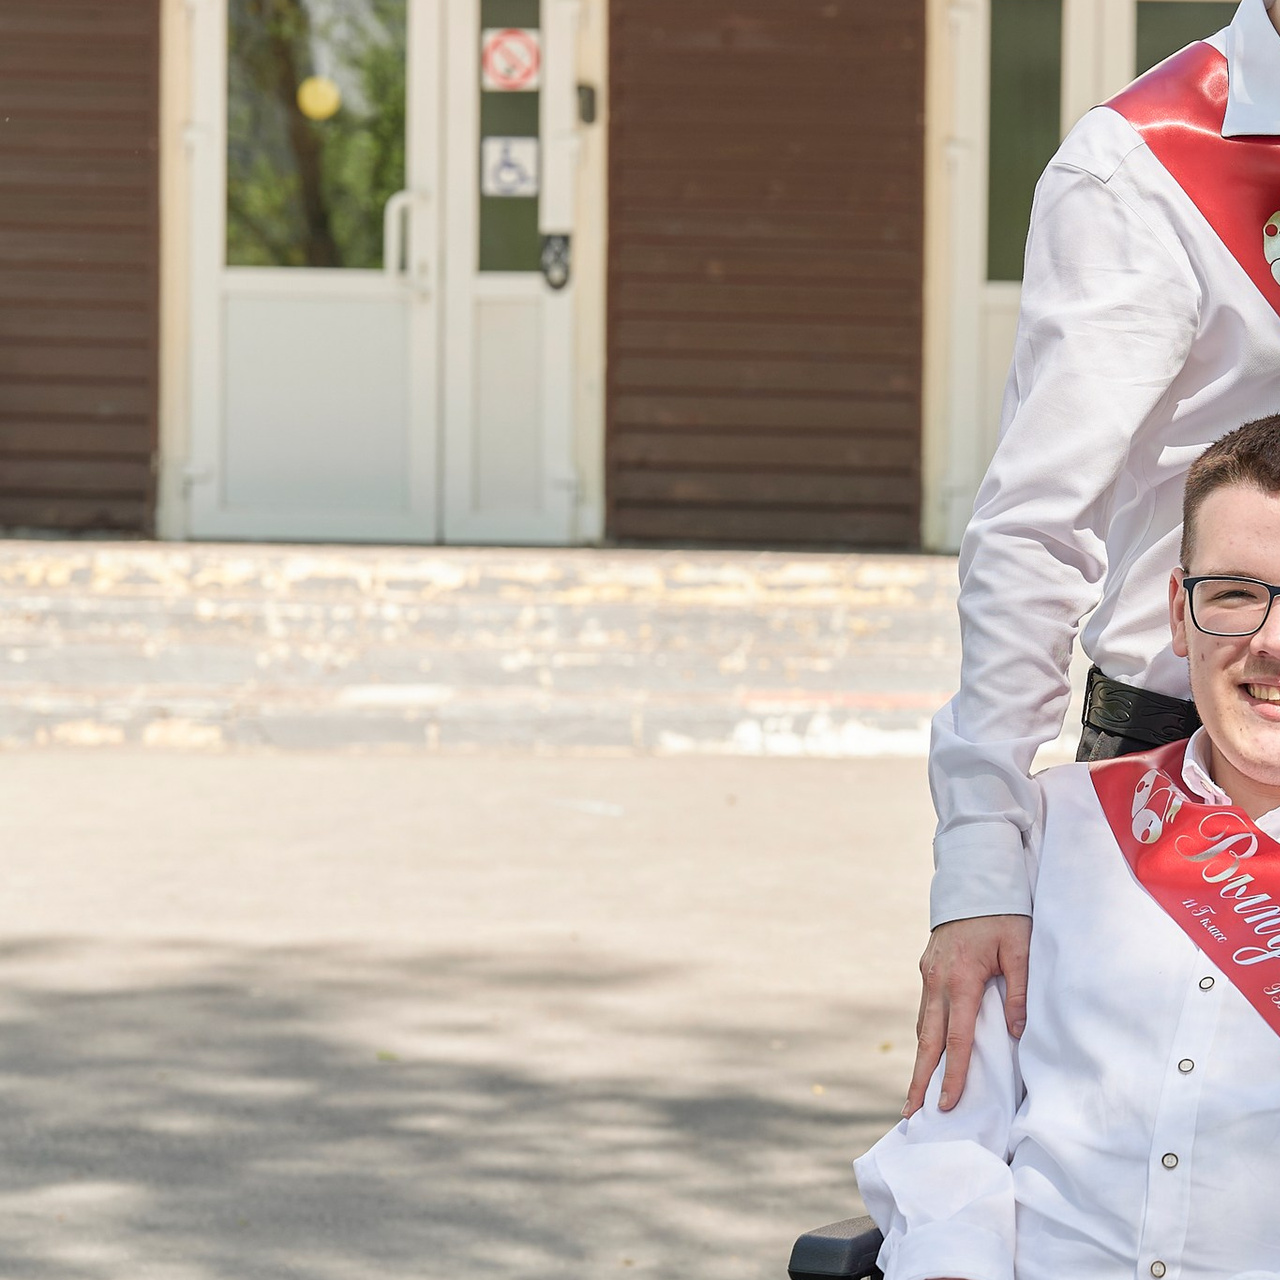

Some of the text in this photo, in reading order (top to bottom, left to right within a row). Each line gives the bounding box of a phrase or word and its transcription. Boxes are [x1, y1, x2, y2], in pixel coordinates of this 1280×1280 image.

[1182, 898, 1227, 943] 11 Г класс
